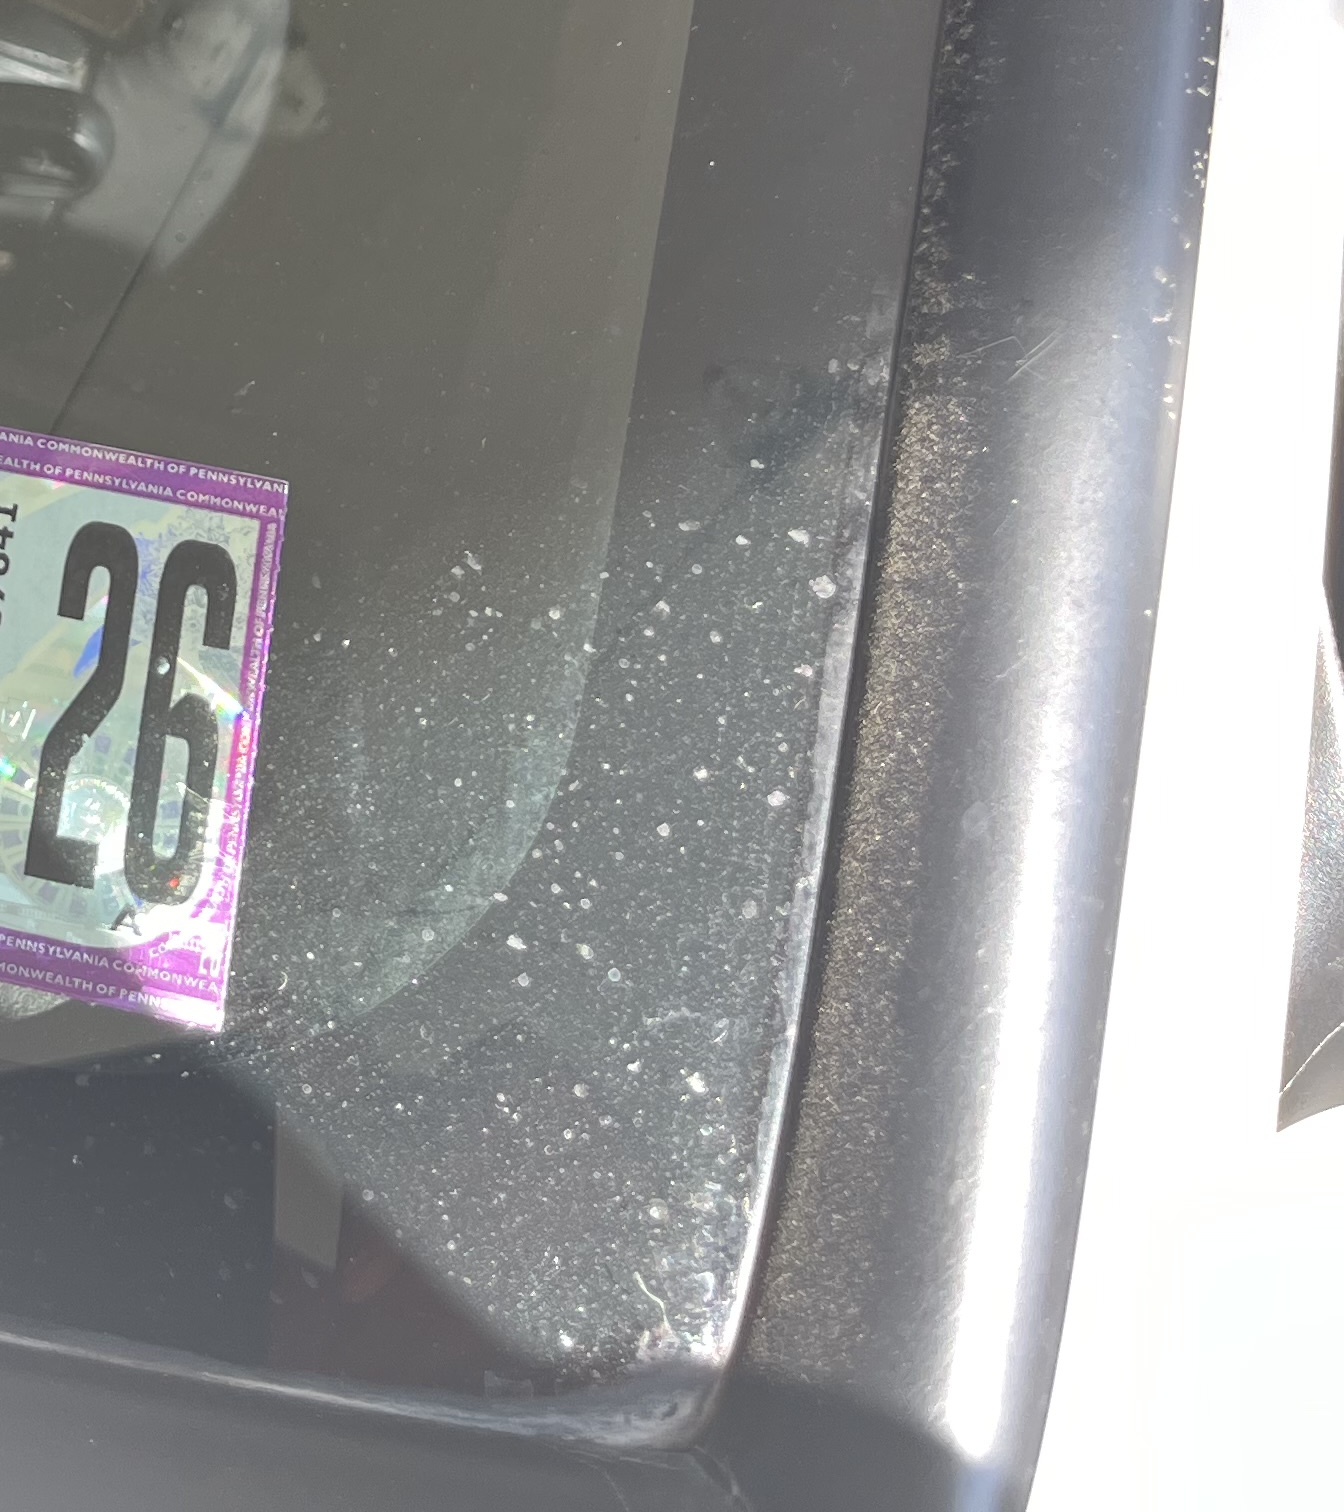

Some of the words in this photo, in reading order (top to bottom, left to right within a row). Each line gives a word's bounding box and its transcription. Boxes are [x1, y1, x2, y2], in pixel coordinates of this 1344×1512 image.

[36, 437, 165, 471] COMMONWEALTH
[166, 461, 186, 475] OF
[42, 463, 63, 476] OF
[64, 467, 175, 497] PENNSYLVANIA
[24, 521, 238, 908] 26
[95, 981, 116, 996] OF
